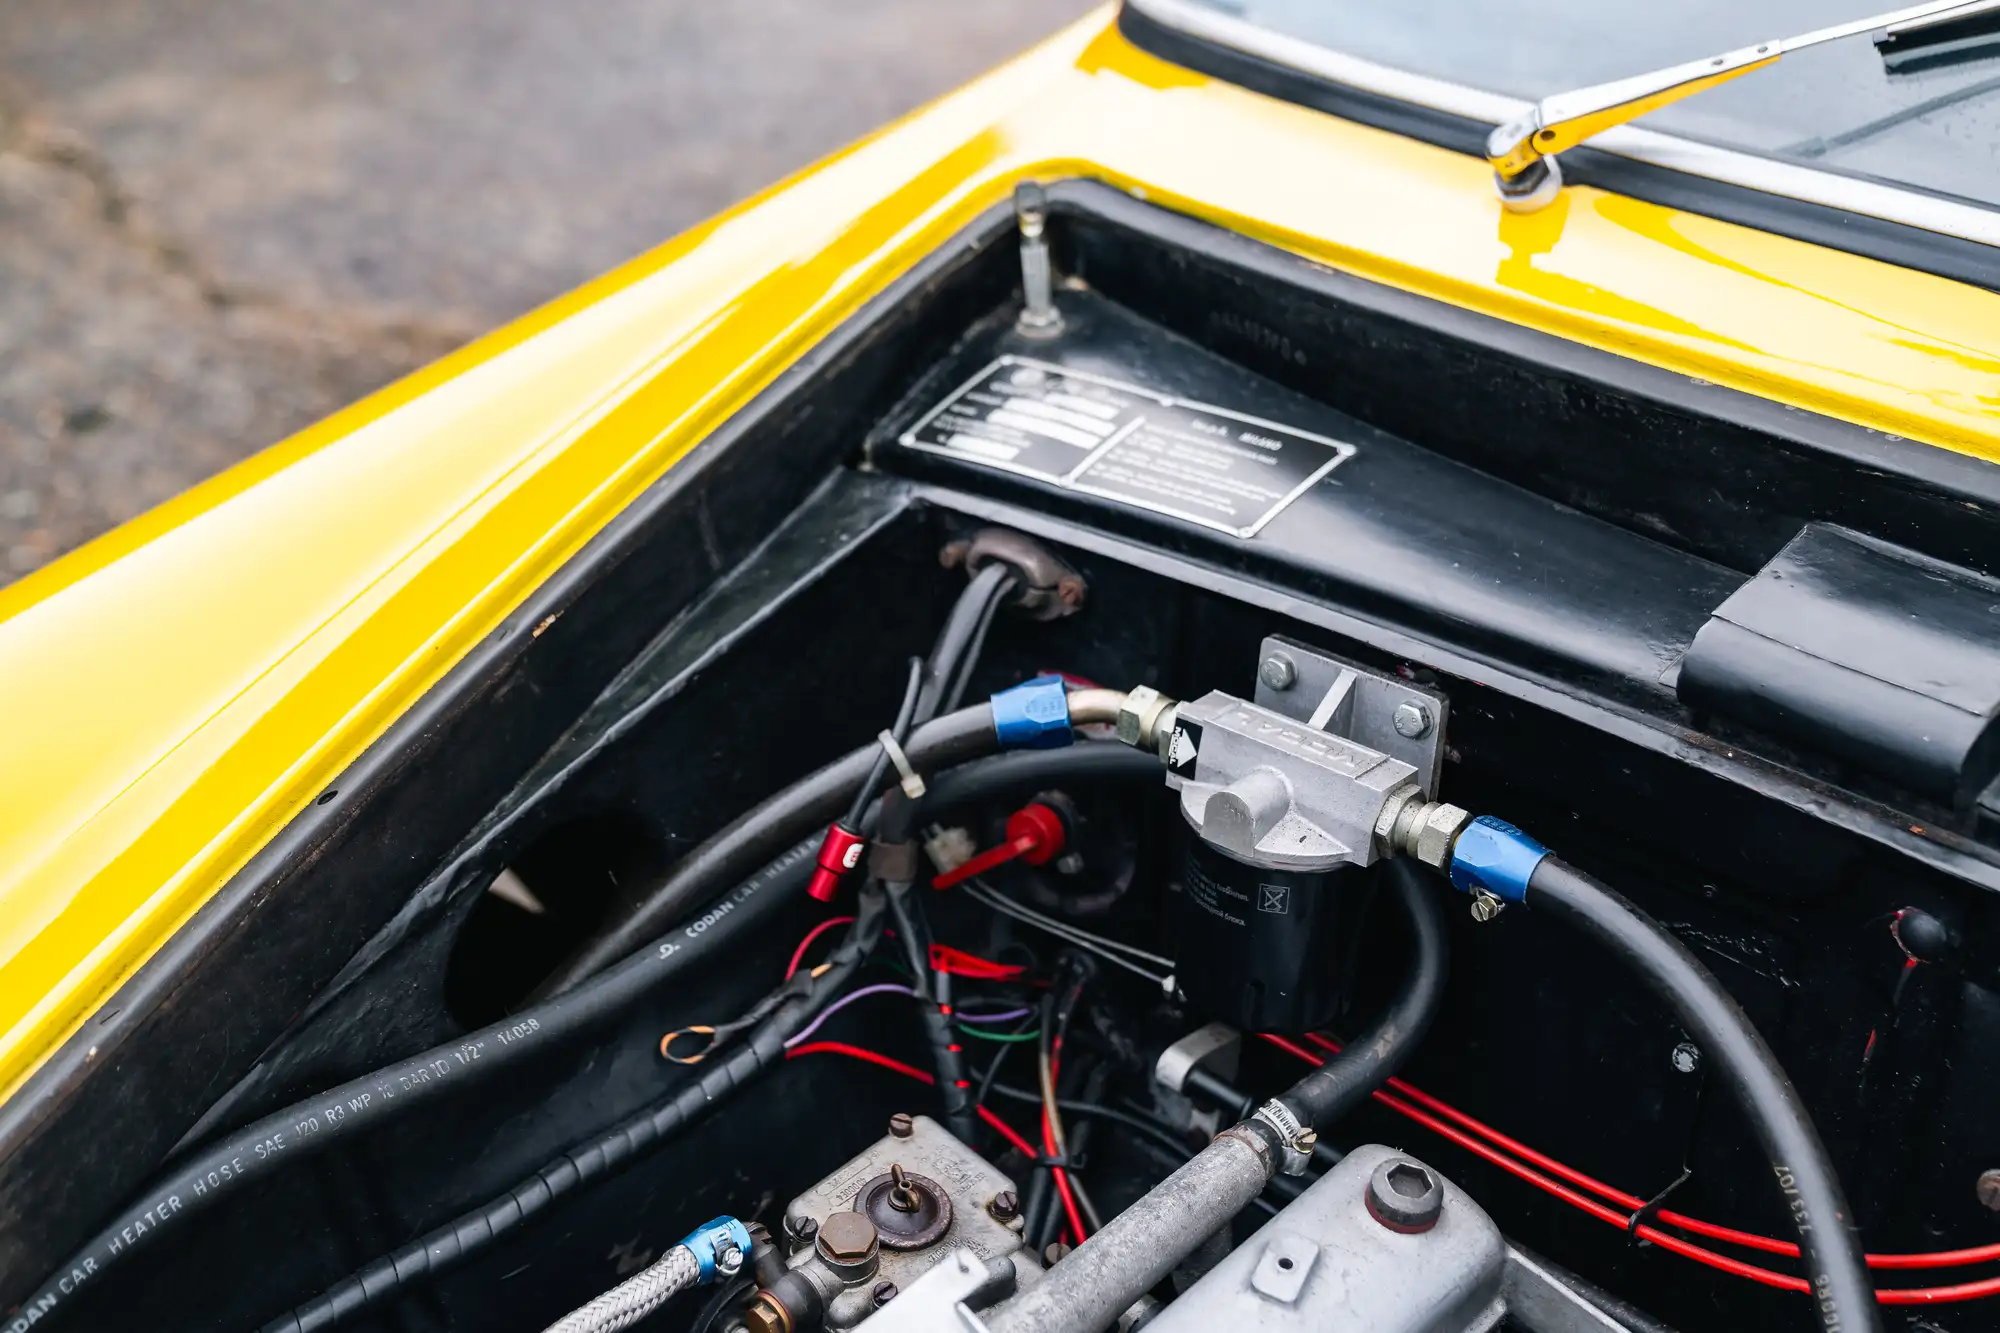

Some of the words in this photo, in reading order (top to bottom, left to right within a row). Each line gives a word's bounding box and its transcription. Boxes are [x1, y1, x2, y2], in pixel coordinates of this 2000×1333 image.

[1168, 725, 1181, 765] MOCAL
[685, 901, 735, 938] CODAN
[2, 1292, 58, 1333] DAN
[58, 1256, 99, 1294] CAR
[108, 1195, 182, 1255] HEATER
[193, 1158, 245, 1197] HOSE
[254, 1133, 286, 1159] SAE
[325, 1105, 344, 1123] R3
[348, 1093, 371, 1113] WP
